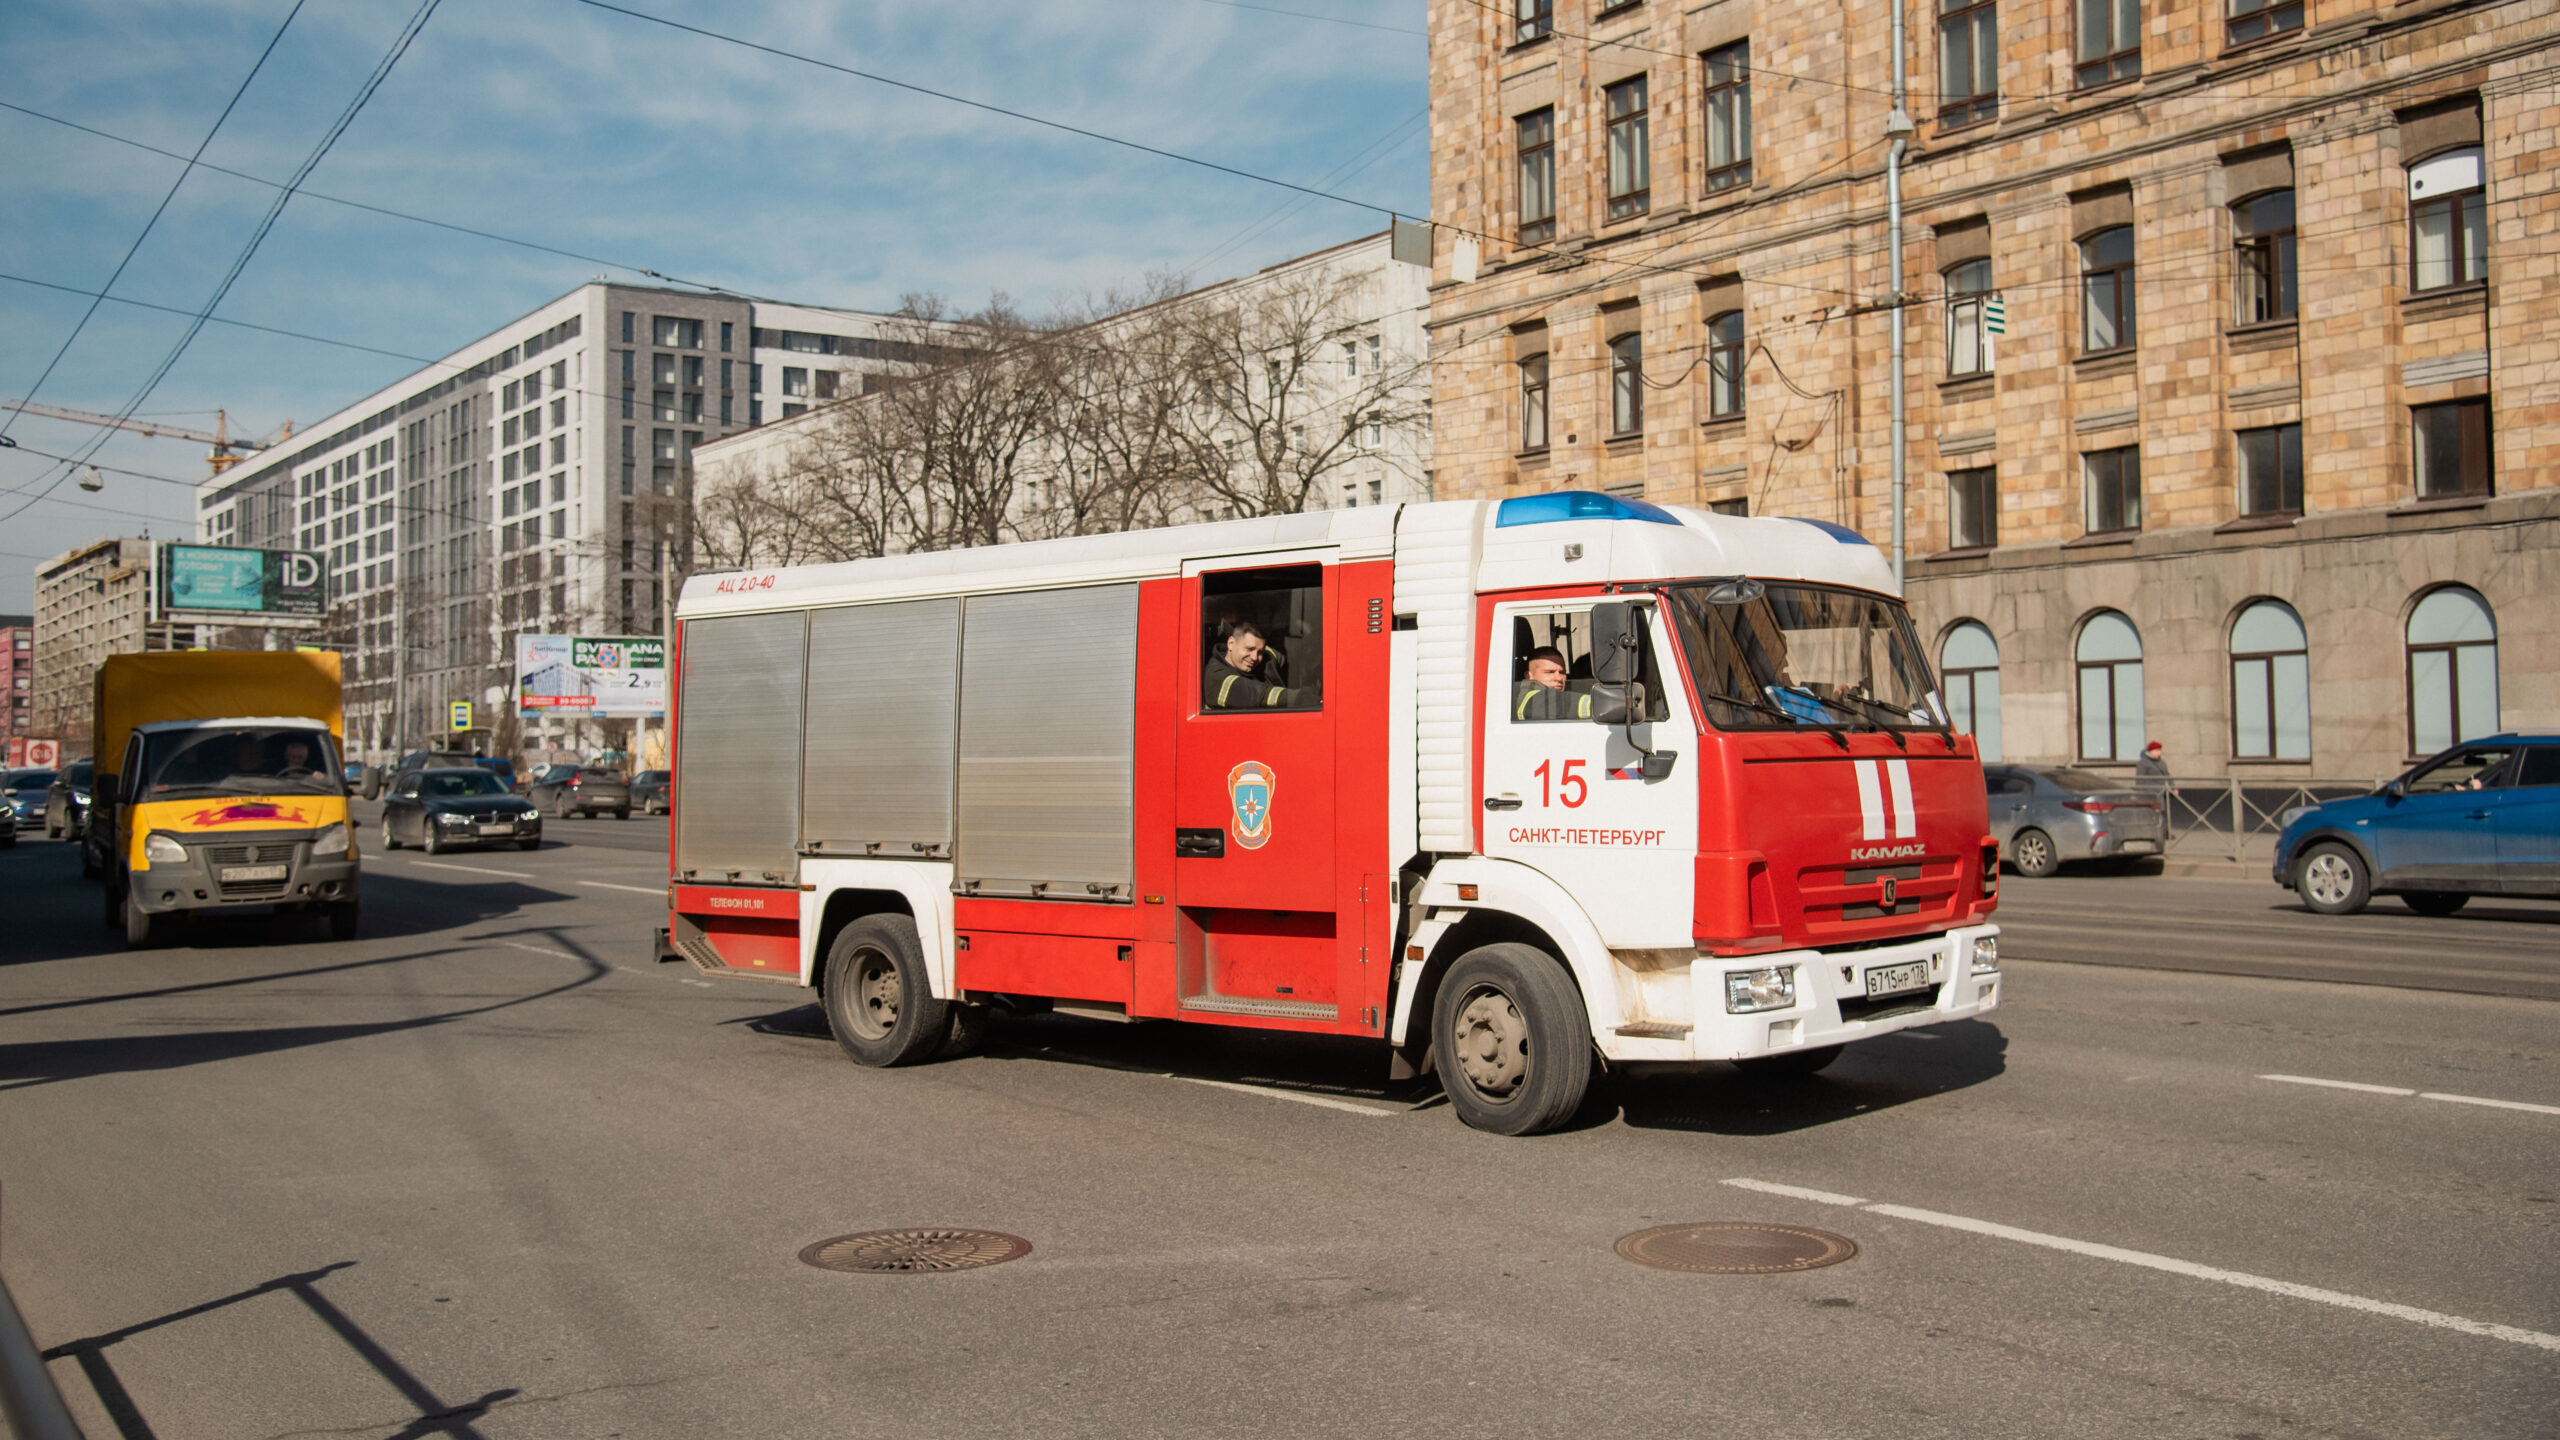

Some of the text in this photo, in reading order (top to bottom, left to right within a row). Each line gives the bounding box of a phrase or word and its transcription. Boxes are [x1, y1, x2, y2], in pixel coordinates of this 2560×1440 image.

[716, 578, 736, 594] АЦ
[1533, 758, 1588, 809] 15
[1508, 827, 1667, 846] САНКТ-ПЕТЕРБУРГ
[1851, 843, 1926, 860] KAMAZ
[709, 897, 743, 909] ТЕЛЕФОН
